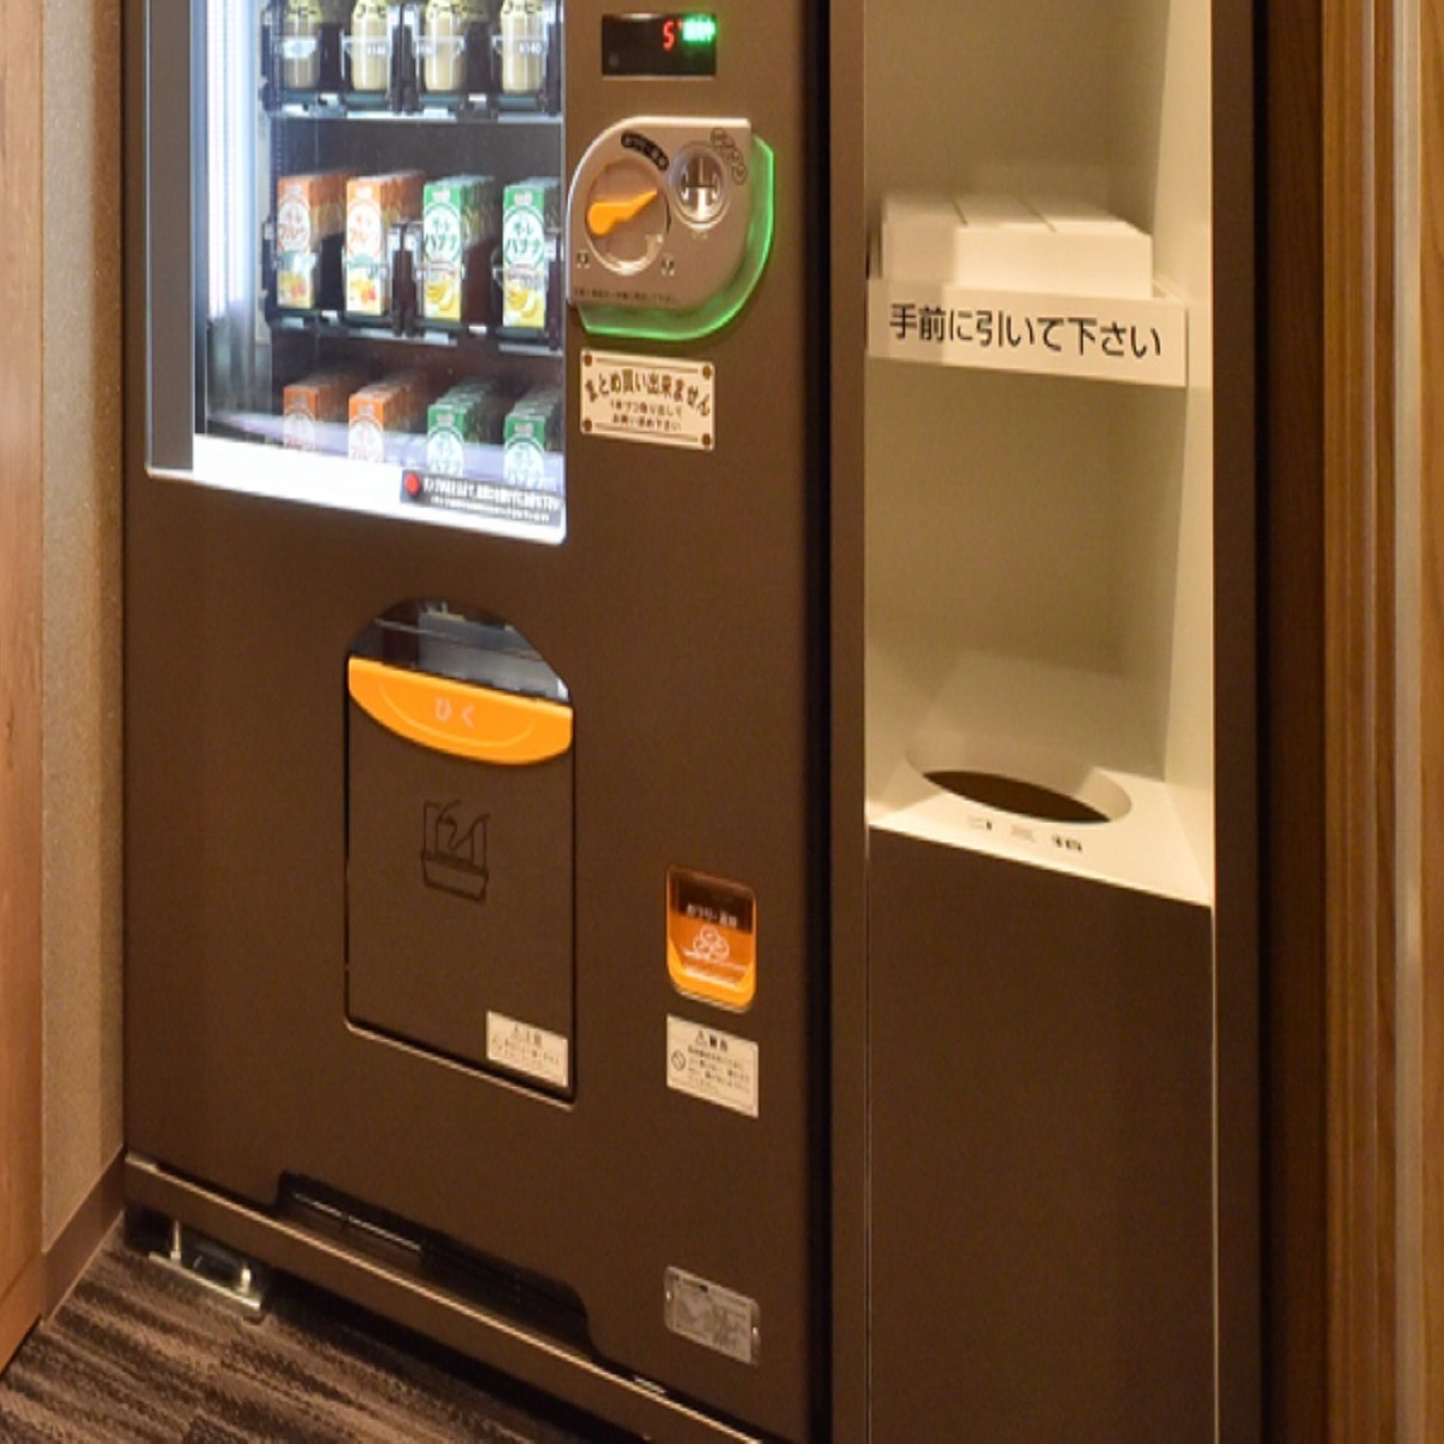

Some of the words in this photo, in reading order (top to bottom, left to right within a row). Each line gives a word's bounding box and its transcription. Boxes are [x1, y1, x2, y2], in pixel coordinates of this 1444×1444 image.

[889, 303, 1162, 358] 手前に引いて下さい
